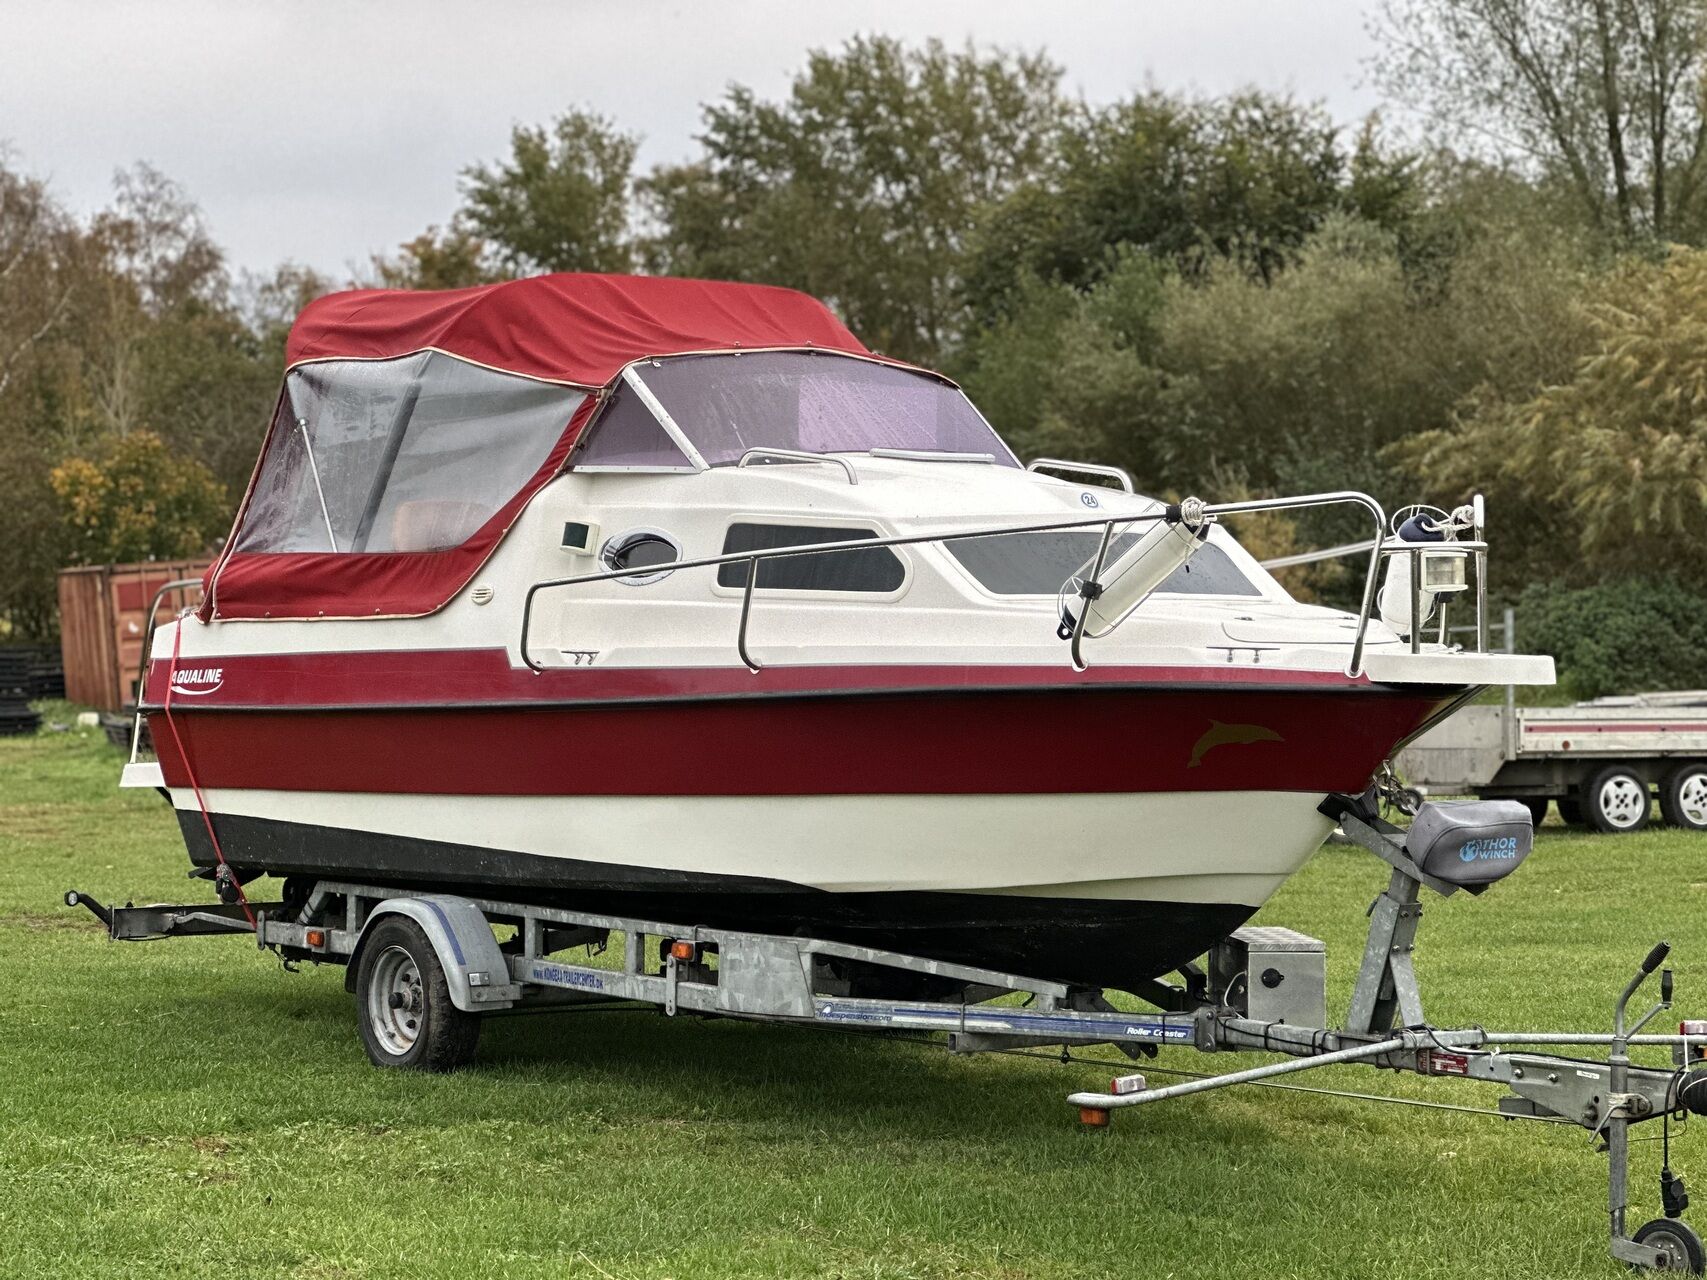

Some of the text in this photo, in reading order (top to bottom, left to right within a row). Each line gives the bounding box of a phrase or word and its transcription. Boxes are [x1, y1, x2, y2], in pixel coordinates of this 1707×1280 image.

[171, 669, 223, 684] AQUALINE
[1481, 837, 1517, 850] THOR
[1480, 849, 1516, 860] WINCH
[1126, 1027, 1151, 1036] Roller
